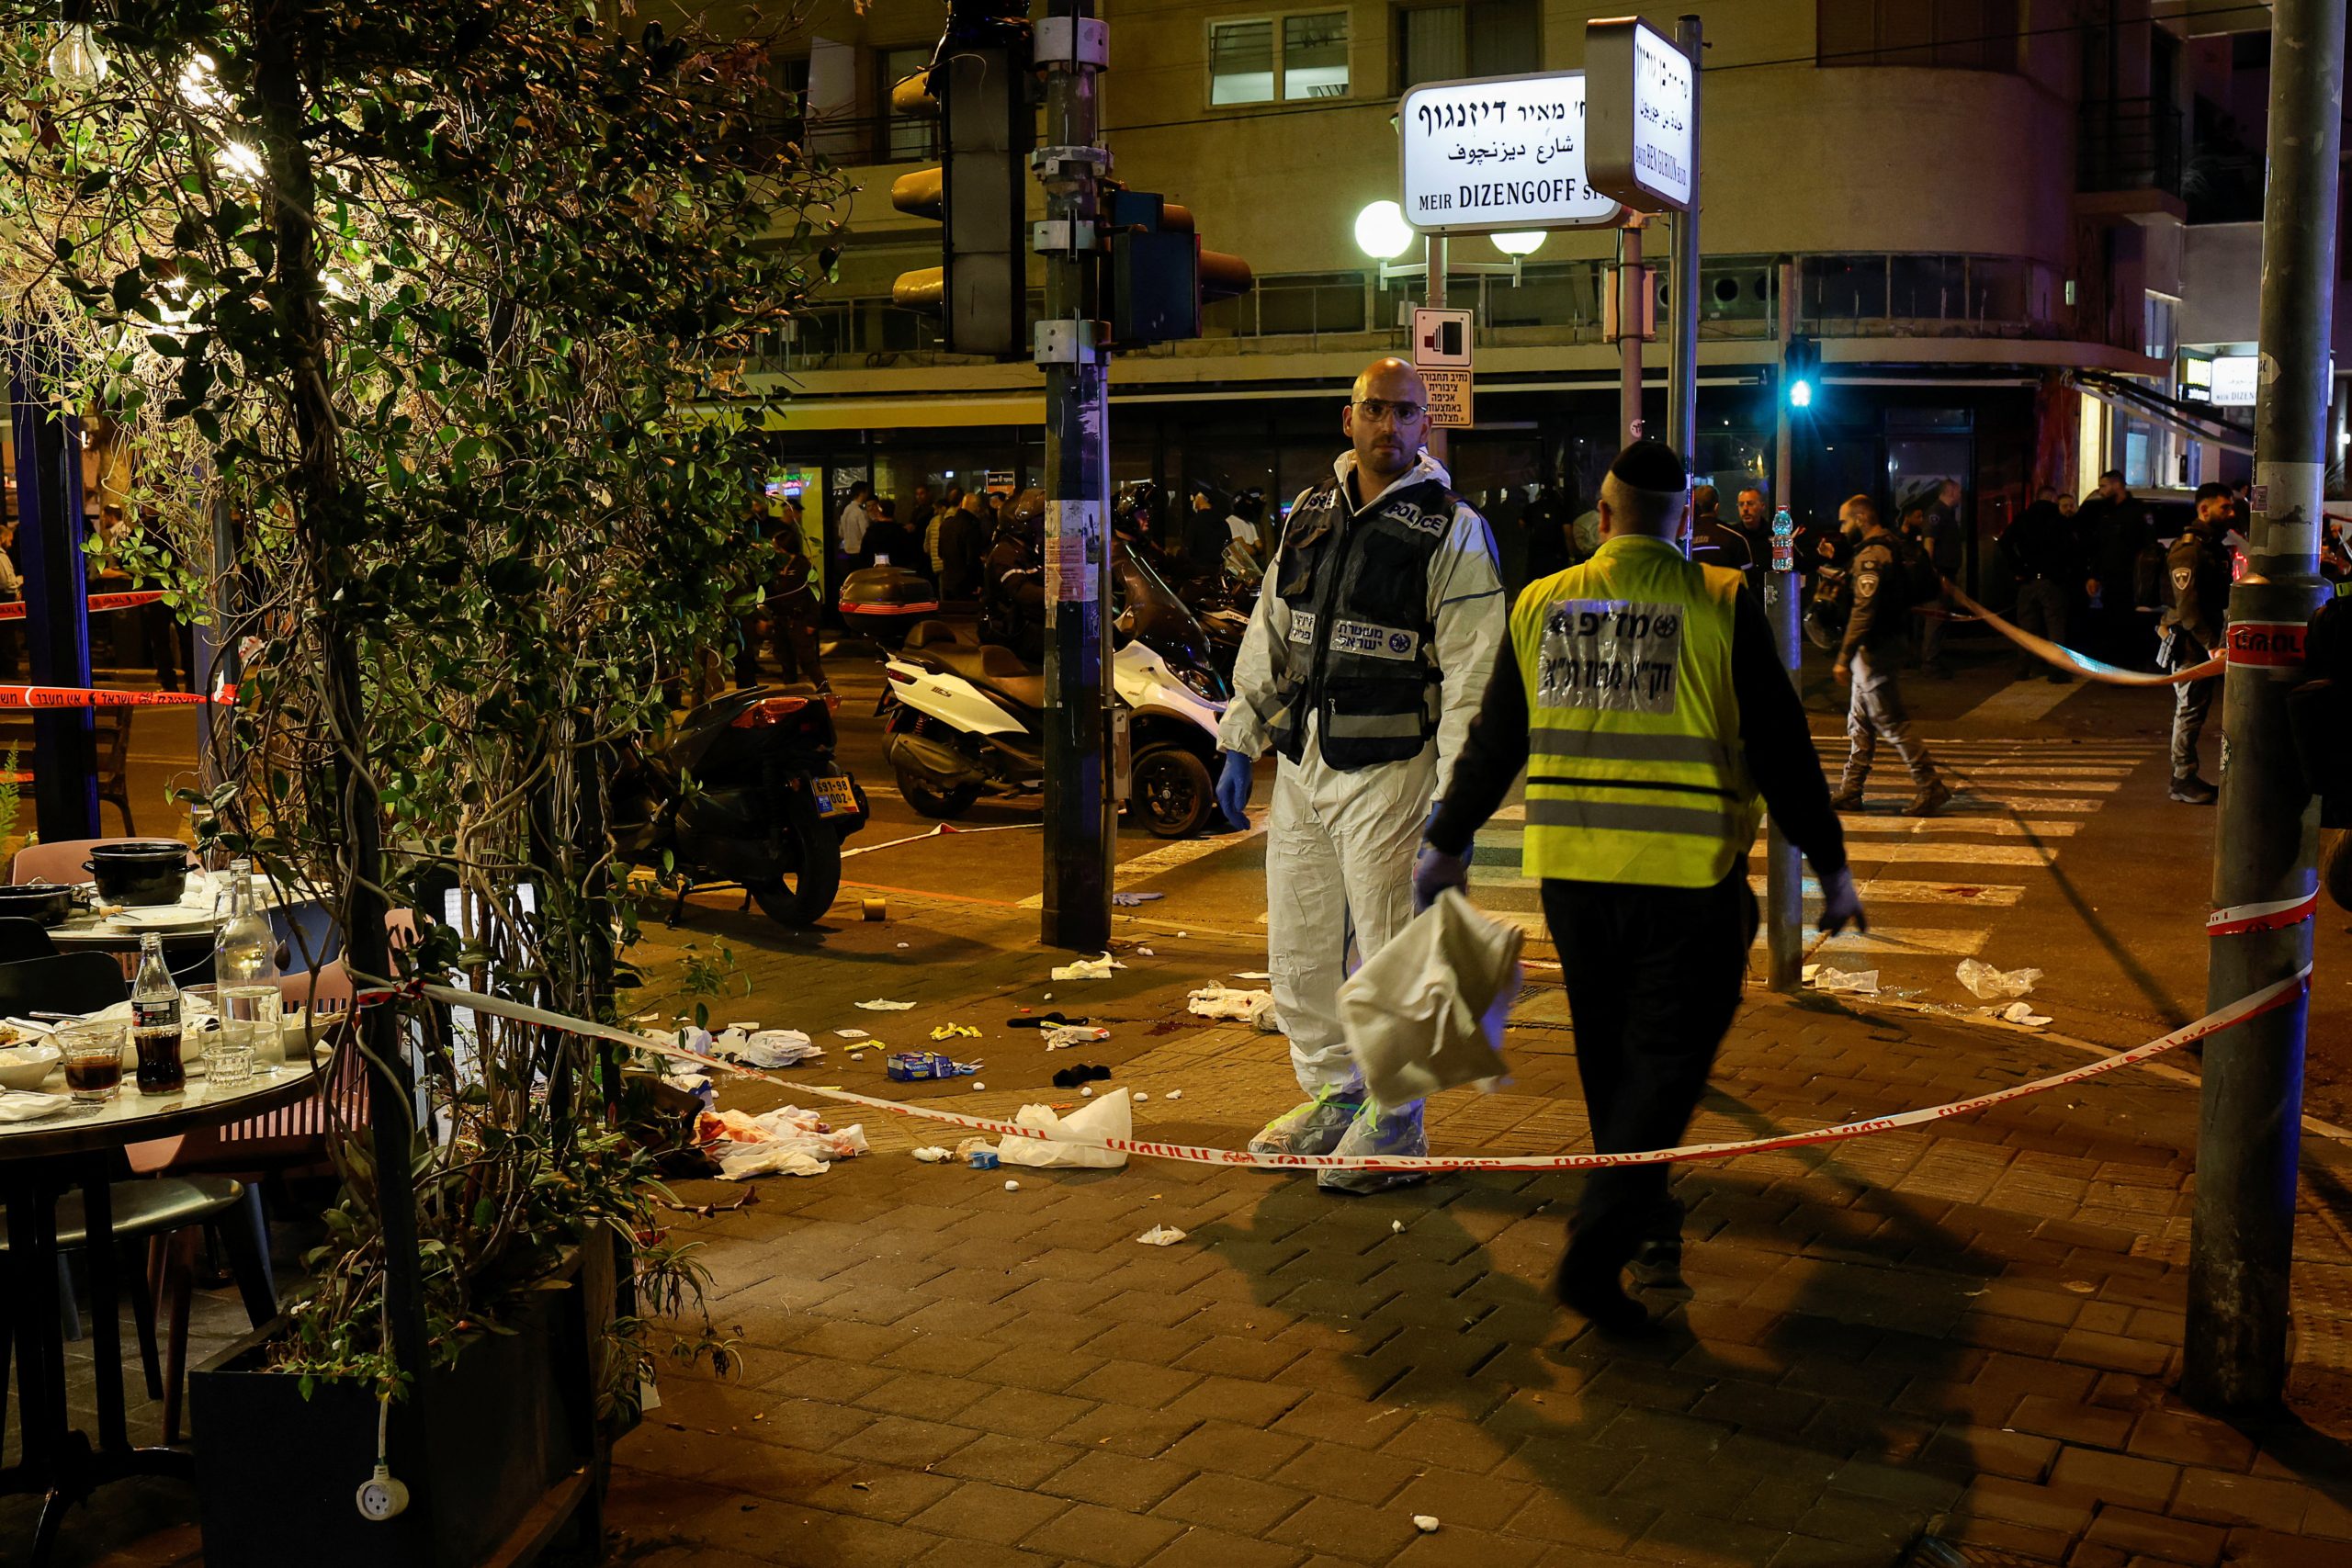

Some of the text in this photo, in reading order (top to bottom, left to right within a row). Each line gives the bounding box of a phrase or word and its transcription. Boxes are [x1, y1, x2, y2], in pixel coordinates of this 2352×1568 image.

[1419, 101, 1507, 138] דיזנגוף
[1518, 102, 1566, 122] מאיר
[1537, 135, 1574, 164] شارع
[1646, 143, 1657, 172] BEN
[1657, 149, 1678, 182] GURION
[1419, 194, 1453, 210] MEIR
[1459, 178, 1576, 208] DIZENGOFF
[1451, 373, 1468, 383] נתיב
[1429, 383, 1458, 392] ציבורית
[1431, 394, 1455, 402] אכיפה
[1387, 503, 1443, 532] POLICE
[1338, 624, 1384, 639] משטרת
[1339, 634, 1383, 650] ישראל
[37, 693, 64, 705] מעבר
[67, 694, 82, 706] אין
[102, 692, 133, 705] ישראל
[817, 780, 848, 793] 691-98
